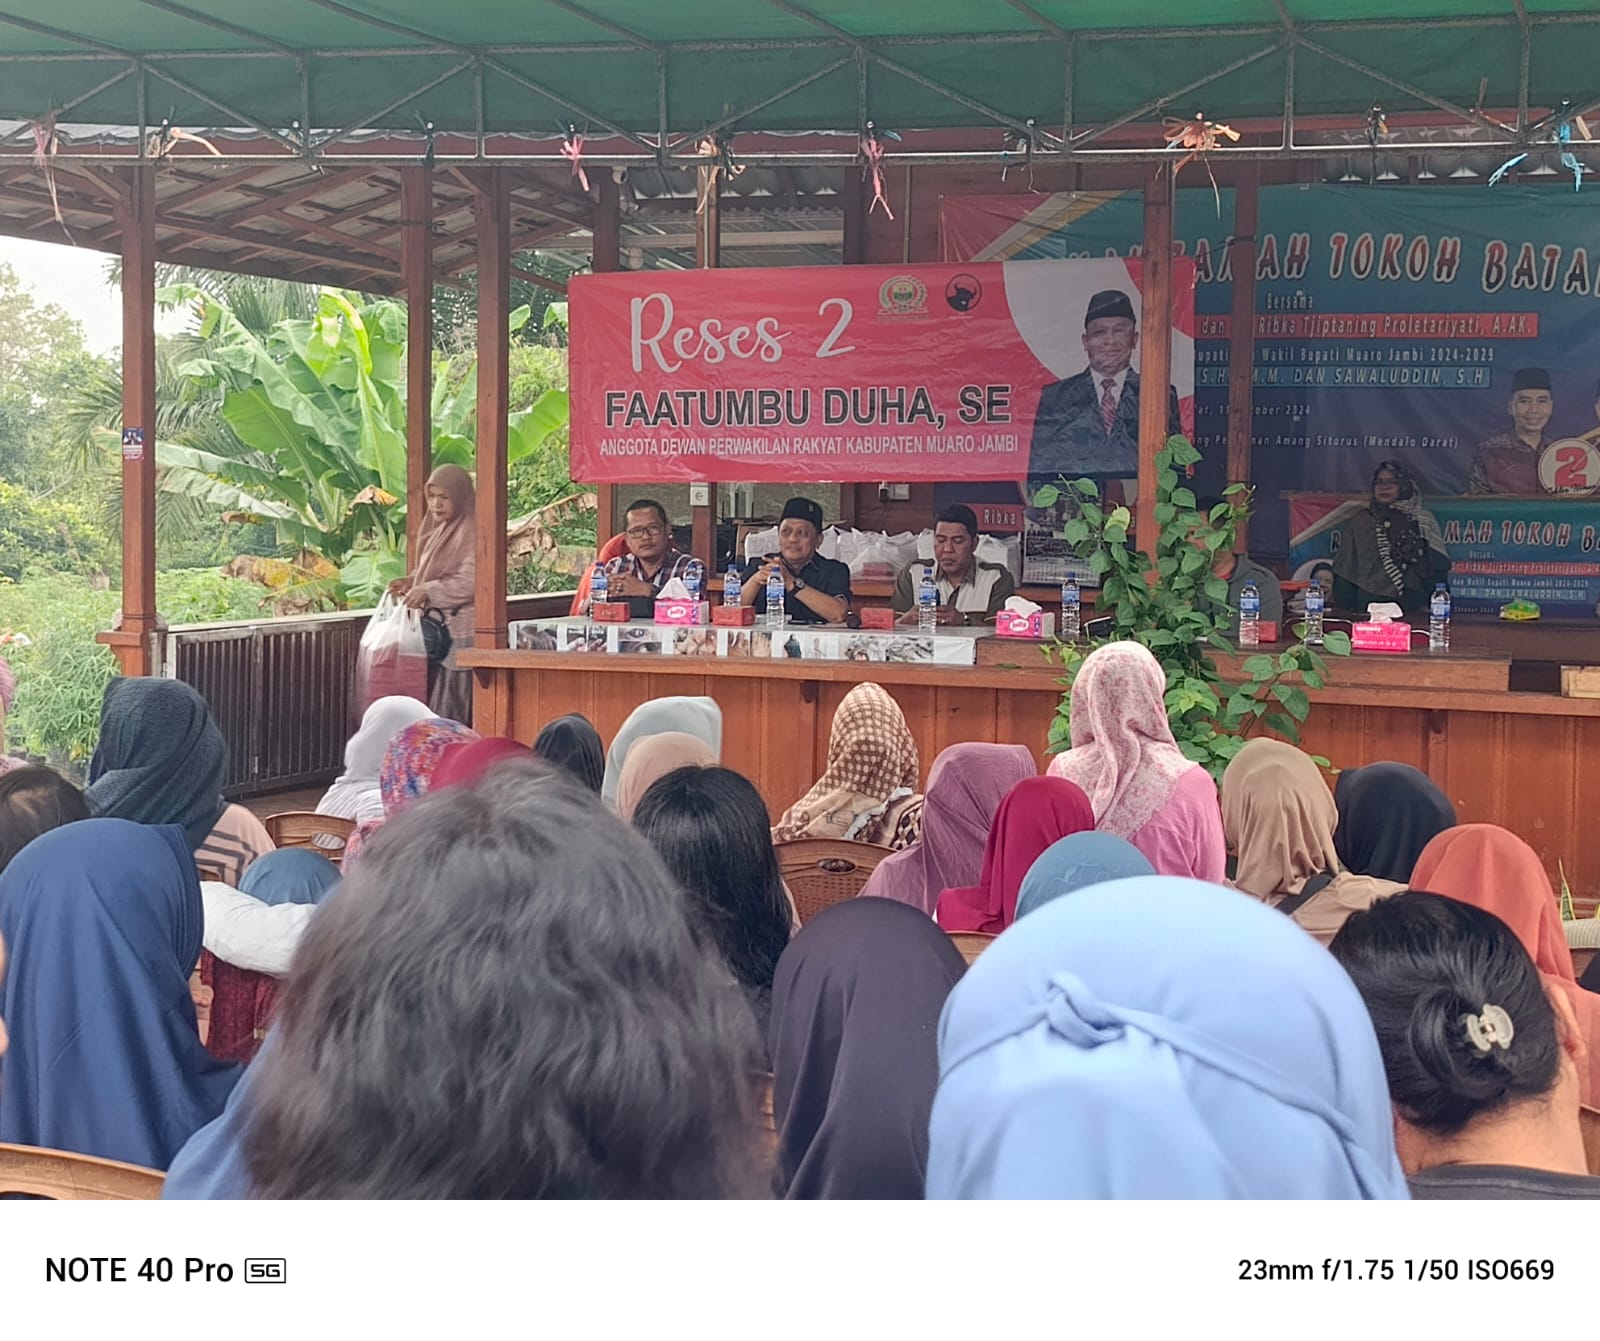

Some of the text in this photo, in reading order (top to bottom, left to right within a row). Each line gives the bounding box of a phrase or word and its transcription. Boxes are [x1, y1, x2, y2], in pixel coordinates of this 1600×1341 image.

[1329, 232, 1461, 283] TOKOH
[1482, 239, 1600, 297] BATA
[1267, 292, 1313, 309] Bersama
[631, 293, 855, 373] Reses 2
[1202, 315, 1532, 338] dan Ribka Tjiptaning Proletariyati, A.AK.
[1198, 348, 1494, 364] upati Wakil Bupati Muaro Jambi 2024-2029
[1294, 368, 1326, 383] DAN
[1334, 368, 1447, 385] SAWALUDDIN,
[1457, 368, 1484, 384] S.H
[605, 384, 1011, 431] FAATUMBU DUHA, SE
[1285, 404, 1311, 415] 2024
[600, 434, 1018, 455] ANGGOTA DEWAN PERWAKILAN RAKYAT KABUPATEN MUARO JAMBI
[1275, 435, 1310, 448] Amang
[1316, 435, 1358, 446] Sitorus
[1363, 435, 1416, 448] (Mendalo
[1421, 435, 1459, 448] Darat)
[1555, 447, 1588, 487] 2
[984, 508, 1016, 525] Ribka
[1502, 520, 1571, 547] TOKOH
